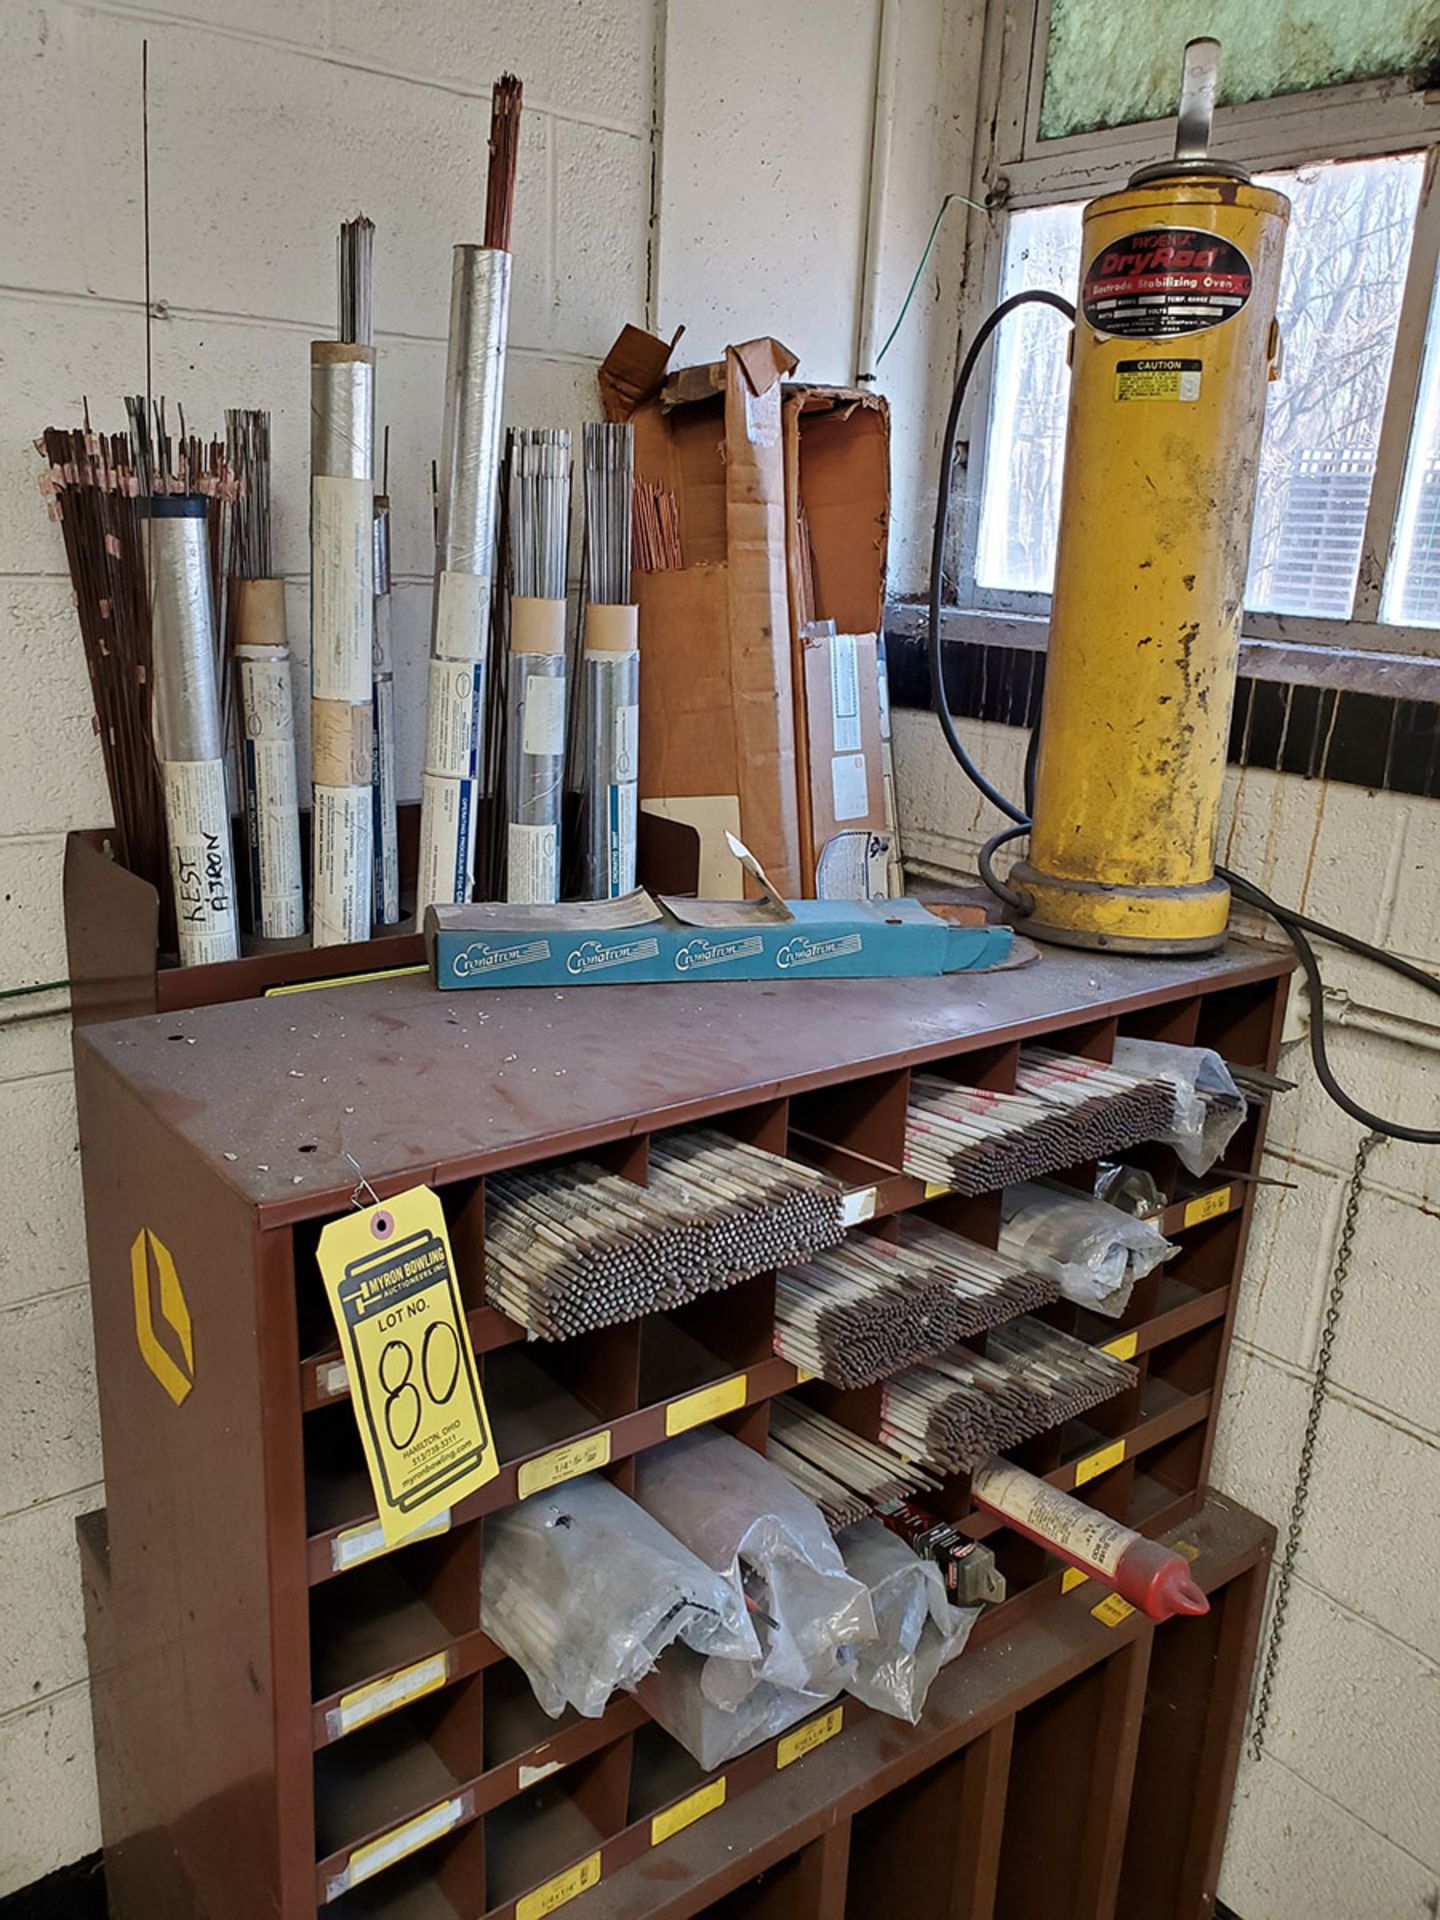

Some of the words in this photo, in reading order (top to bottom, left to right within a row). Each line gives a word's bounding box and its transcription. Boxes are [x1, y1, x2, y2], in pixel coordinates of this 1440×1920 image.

[1103, 247, 1217, 274] DryRod
[1138, 276, 1198, 289] Stabilizing
[1203, 276, 1233, 288] Oven
[1137, 361, 1181, 370] CAUTION
[453, 944, 521, 977] Cronatron
[566, 942, 631, 974] Cronatron
[674, 940, 737, 971] Cronatron
[776, 937, 836, 968] Cronatron
[369, 1266, 404, 1294] MYRON
[403, 1247, 446, 1277] BOWLING
[383, 1268, 433, 1297] AUCTIONEERS
[377, 1308, 403, 1333] LOT
[406, 1298, 430, 1318] NO.
[379, 1321, 460, 1450] 80
[441, 1419, 461, 1435] OHIO
[402, 1440, 472, 1488] myronbowling.com
